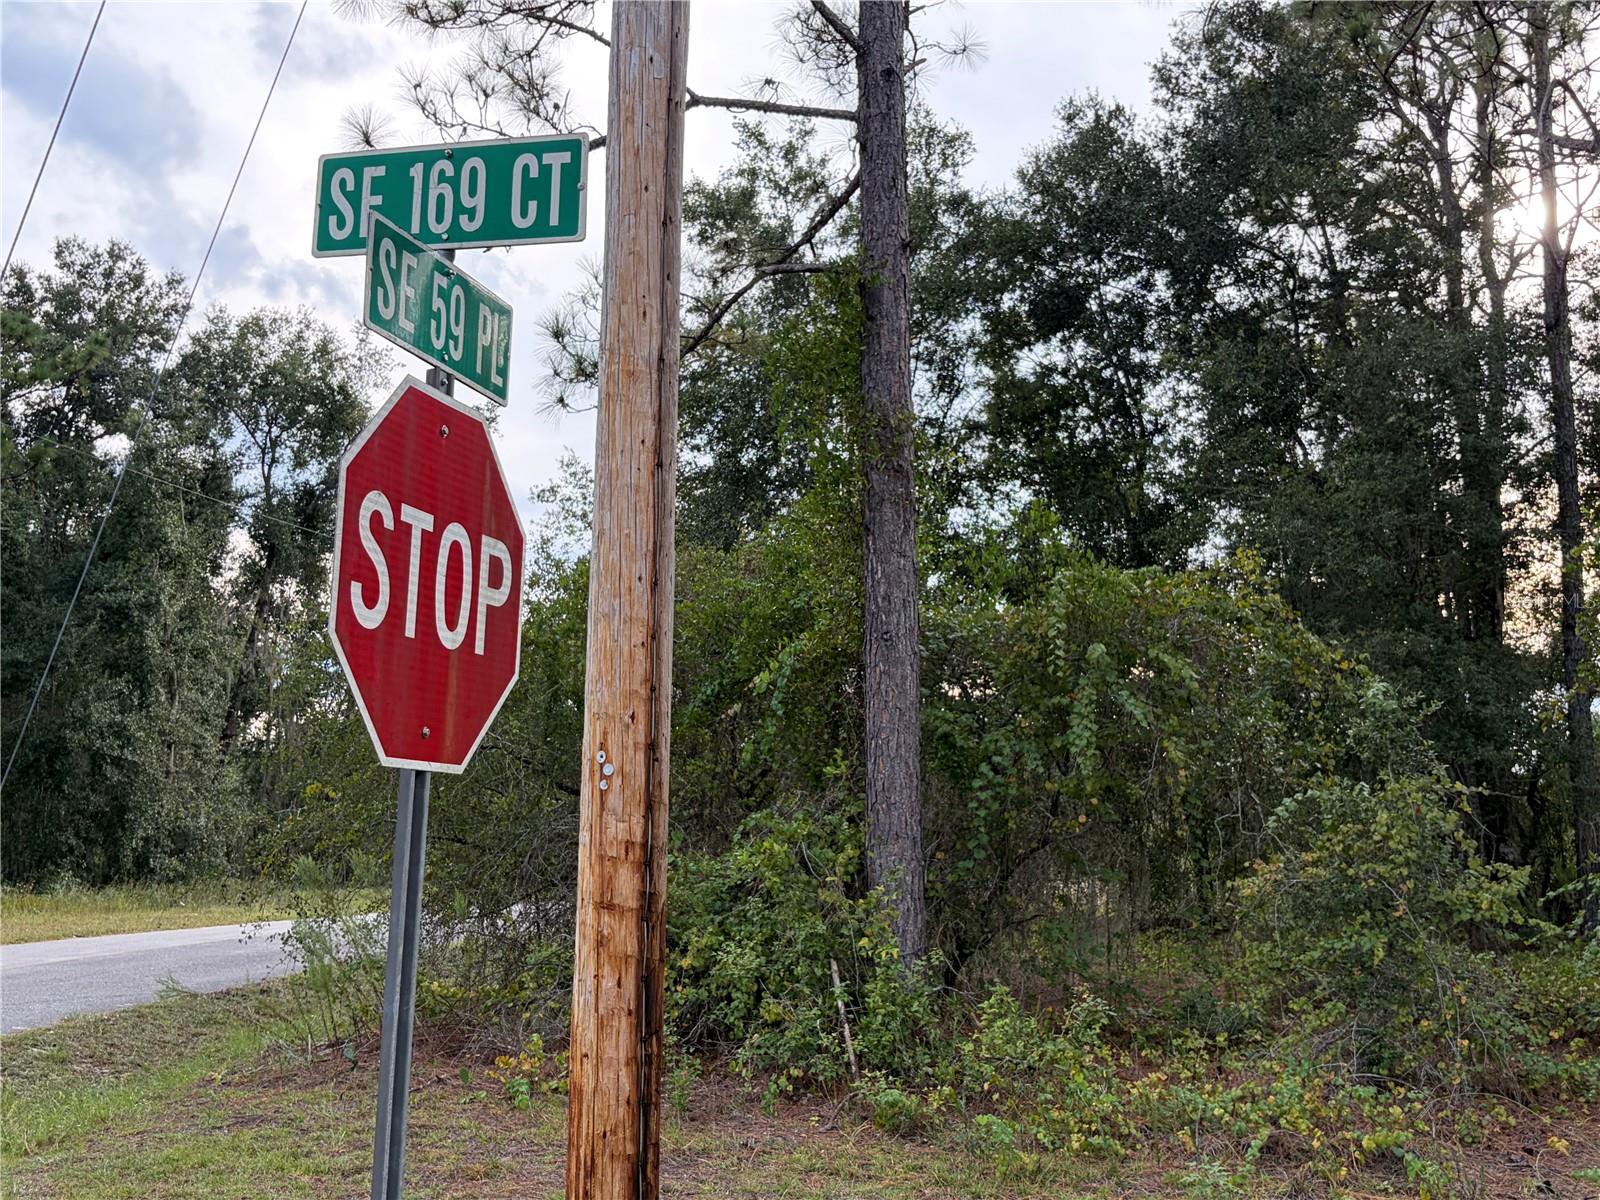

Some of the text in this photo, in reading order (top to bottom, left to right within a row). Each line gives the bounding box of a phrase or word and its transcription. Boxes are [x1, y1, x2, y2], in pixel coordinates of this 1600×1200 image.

[328, 152, 571, 240] SE 169 CT
[377, 238, 503, 388] SE 59 PL
[350, 490, 512, 656] STOP
